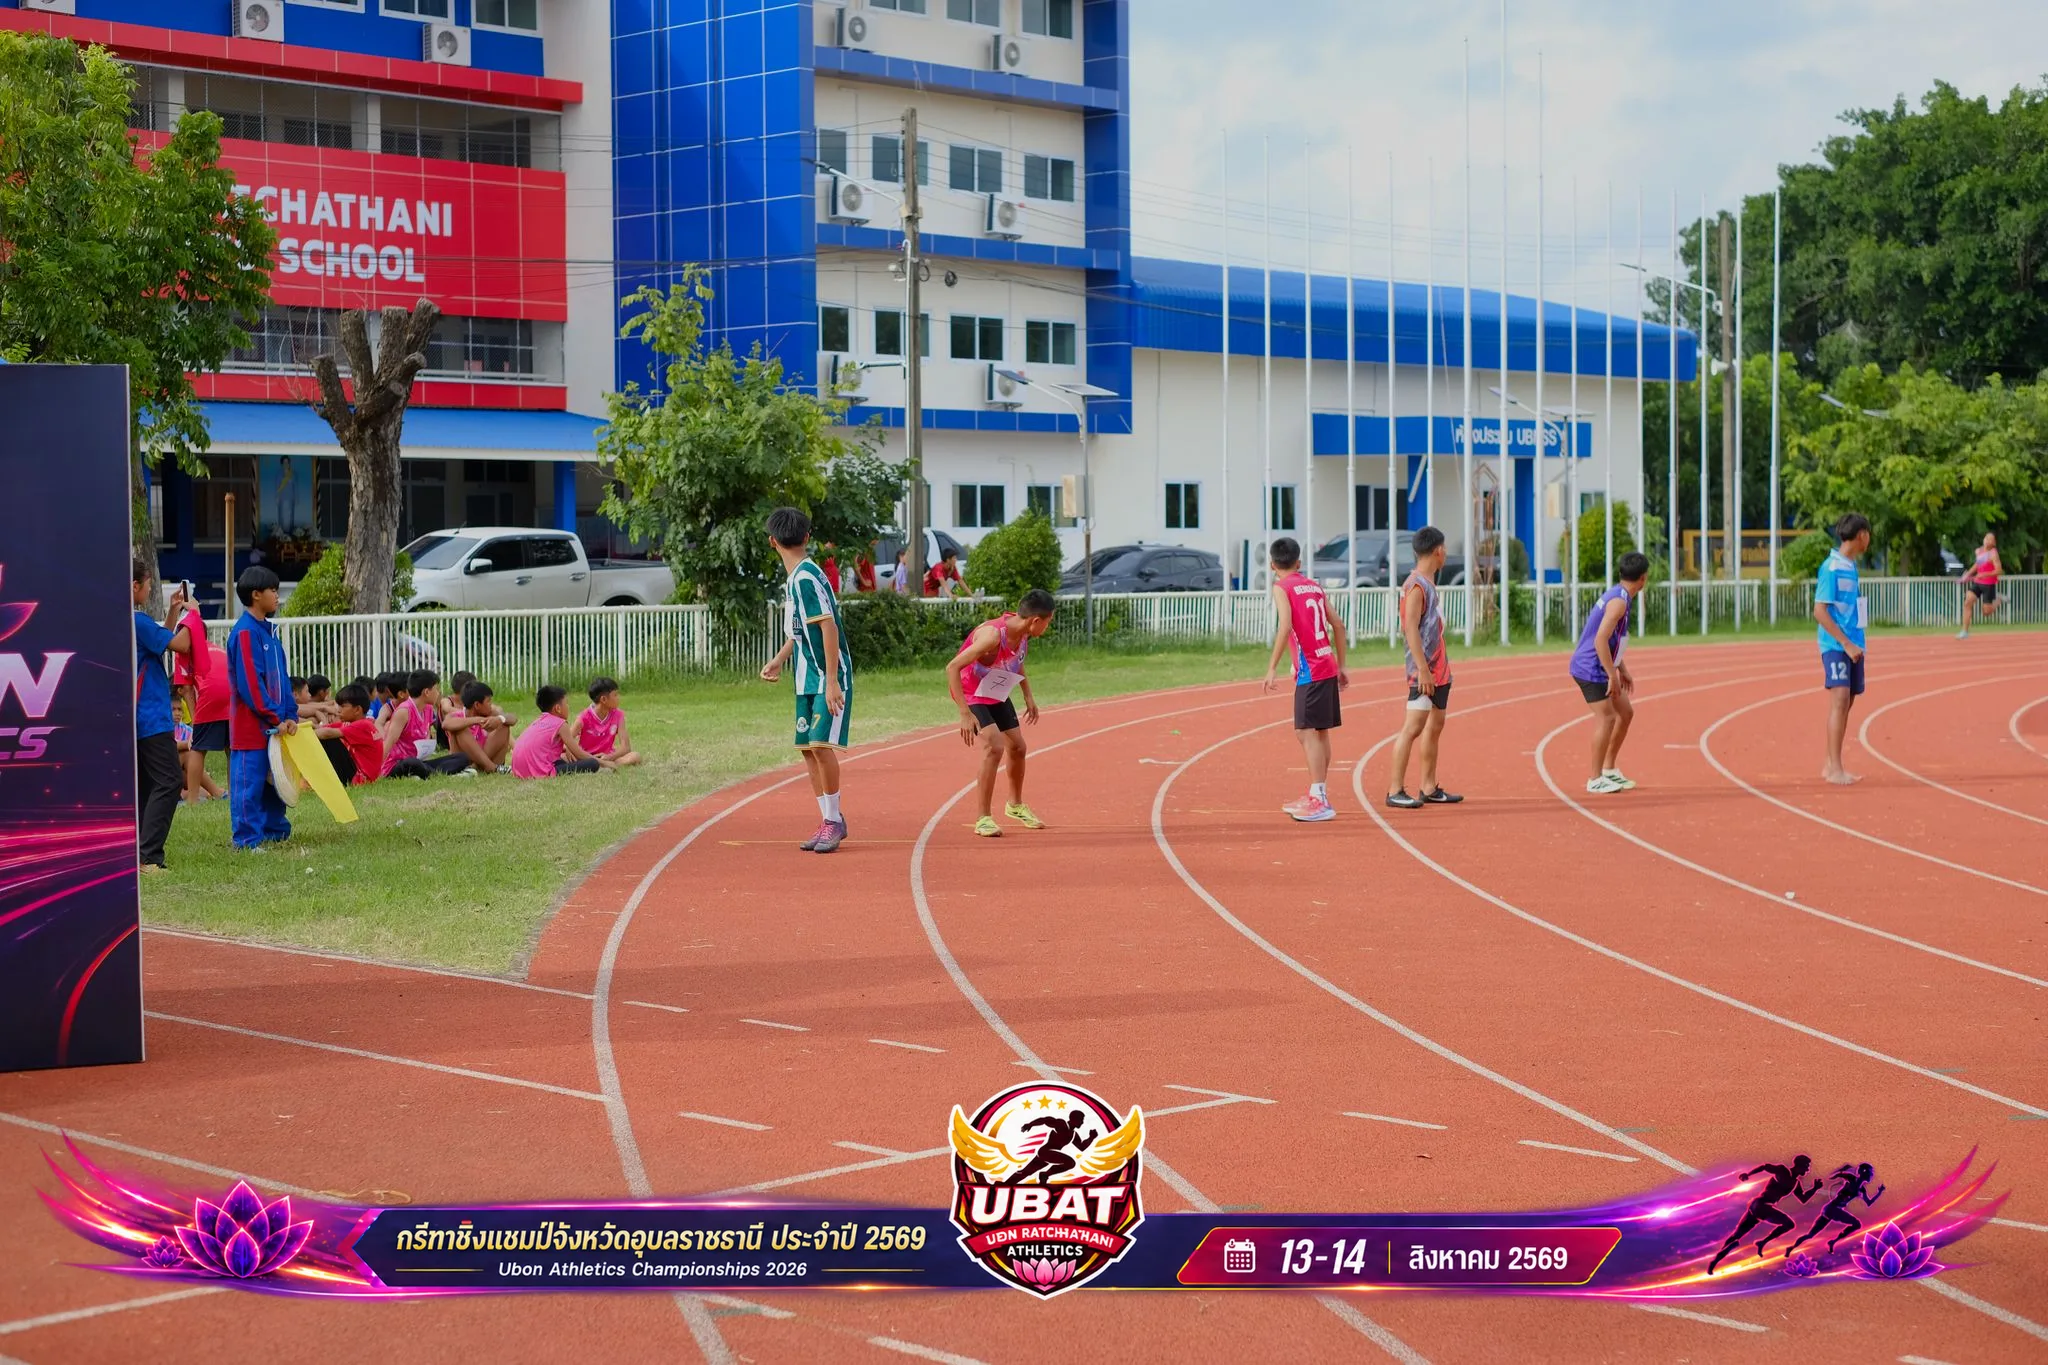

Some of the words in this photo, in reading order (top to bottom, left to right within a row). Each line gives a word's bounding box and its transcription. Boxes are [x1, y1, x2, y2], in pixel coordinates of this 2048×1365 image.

[279, 237, 425, 283] SCHOOL
[1830, 661, 1848, 680] 12
[812, 714, 821, 729] 7
